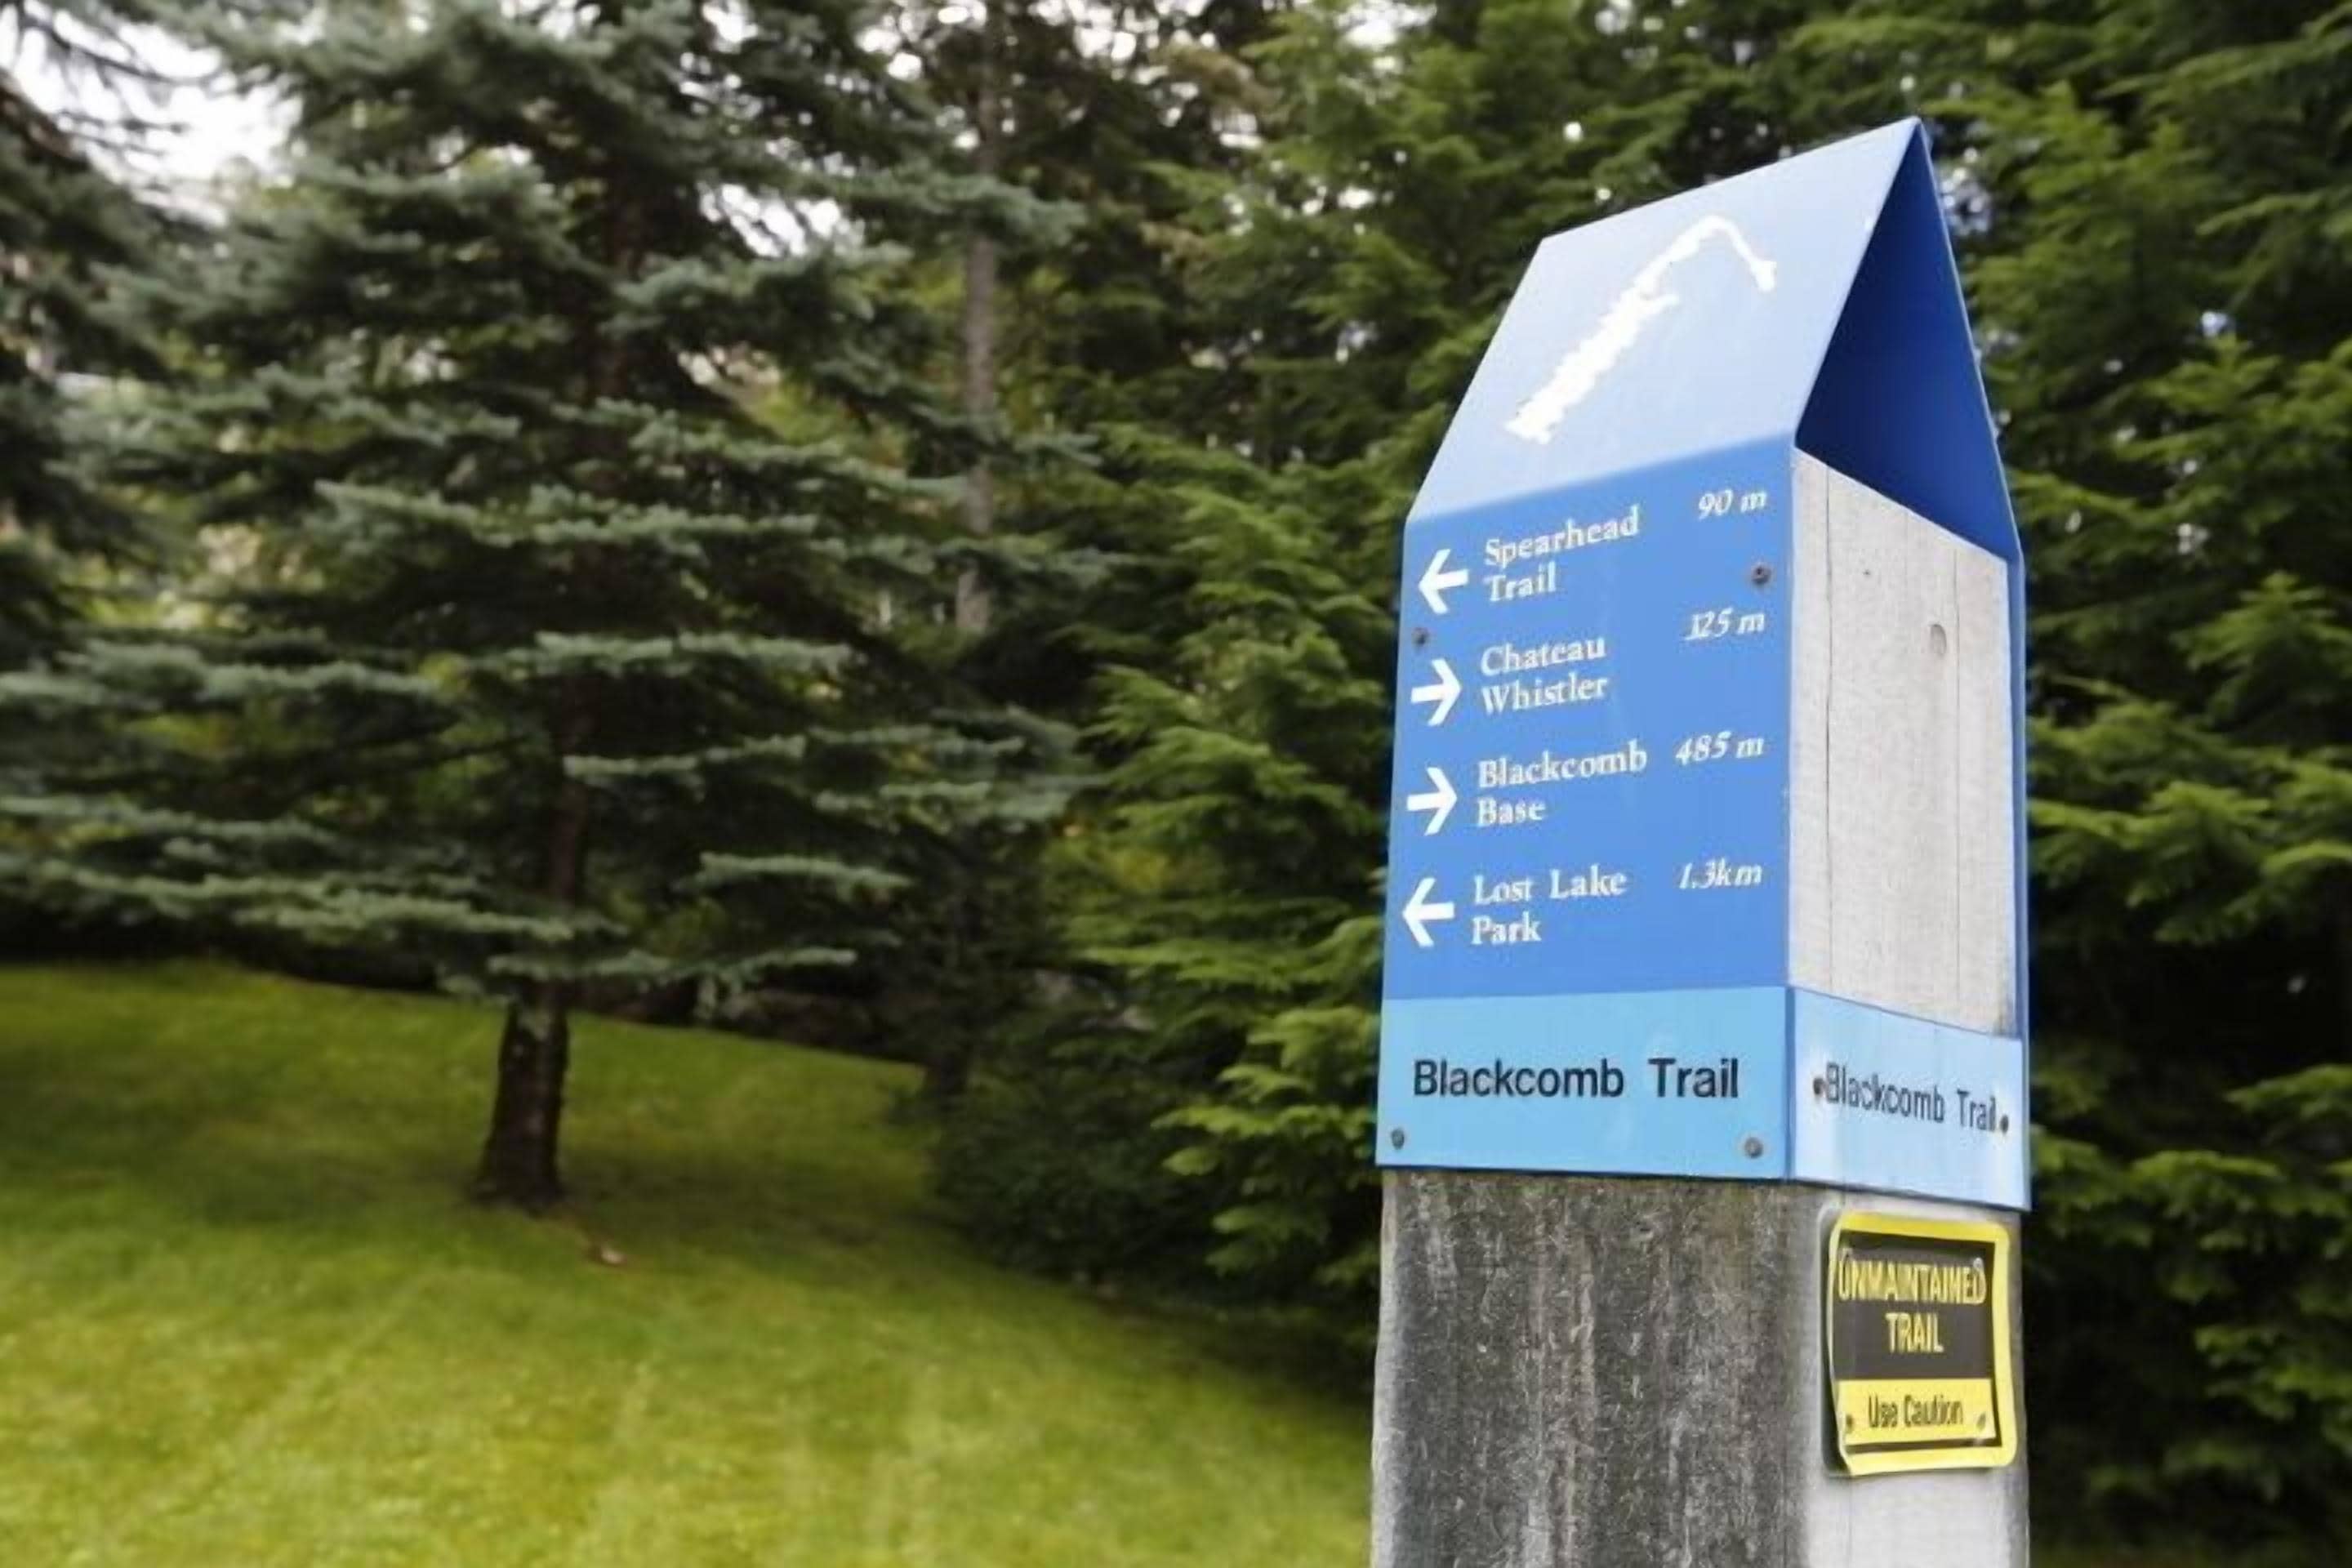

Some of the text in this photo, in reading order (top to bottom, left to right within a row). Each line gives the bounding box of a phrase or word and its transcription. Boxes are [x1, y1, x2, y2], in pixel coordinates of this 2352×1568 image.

[1699, 489, 1766, 521] 90 m
[1485, 505, 1640, 568] Spearhead
[1486, 562, 1557, 602] Trail
[1686, 608, 1765, 641] 125 m
[1481, 636, 1606, 676] Chateau
[1481, 671, 1608, 715] Whistler
[1479, 739, 1647, 789] Blackcomb
[1676, 731, 1764, 766] 485 m
[1477, 797, 1546, 827] Base
[1475, 863, 1628, 906] Lost Lake
[1472, 911, 1542, 946] Park
[1414, 1057, 1738, 1098] Blackcomb Trail
[1825, 1061, 1998, 1134] Blackcomb Trail
[1838, 1256, 1986, 1305] UNMAINTAINED
[1885, 1312, 1944, 1353] TRAIL
[1869, 1394, 1964, 1428] Use Caution
